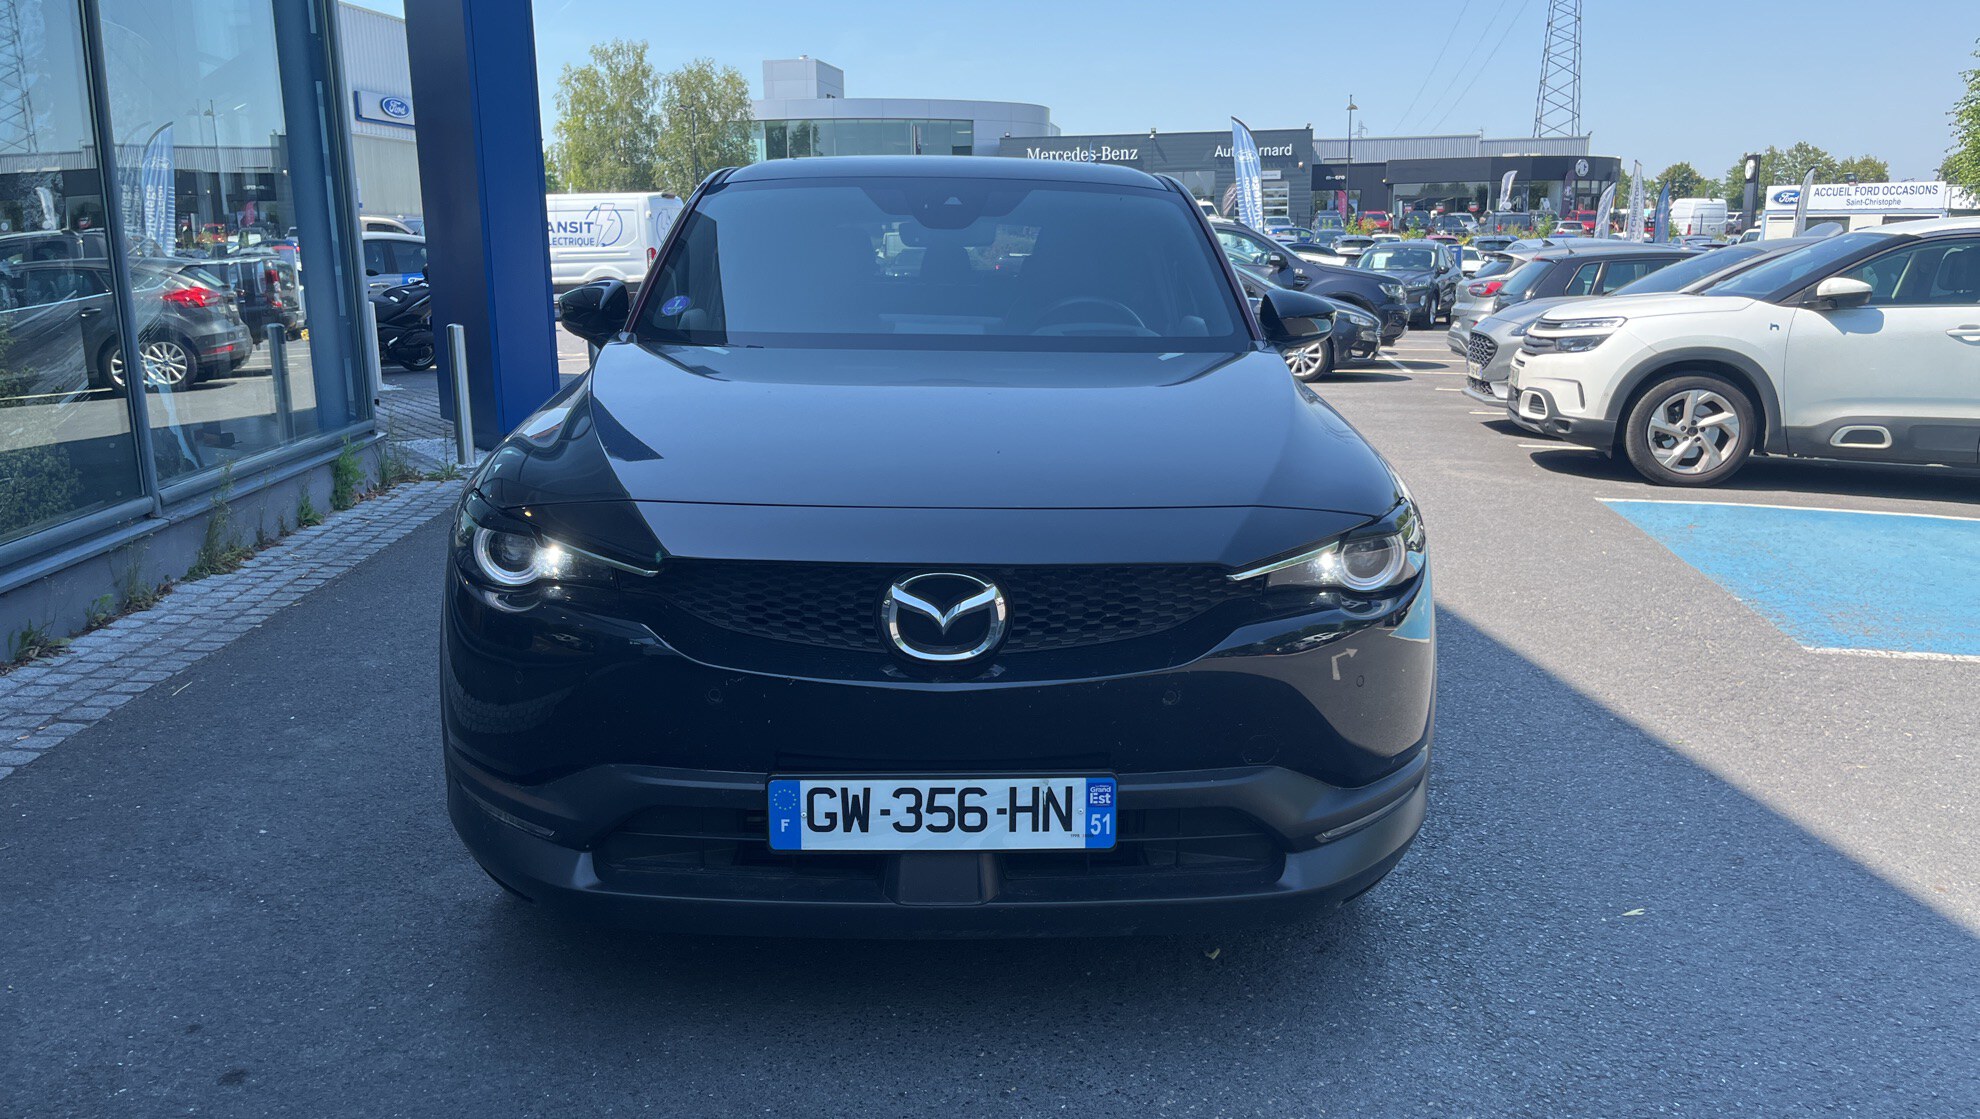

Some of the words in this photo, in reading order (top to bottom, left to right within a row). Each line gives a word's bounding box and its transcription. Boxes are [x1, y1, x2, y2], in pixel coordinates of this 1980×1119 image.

[388, 99, 407, 115] Ford
[1026, 146, 1138, 162] Mercedes-Benz
[1214, 145, 1234, 158] Aut
[1258, 143, 1293, 157] rnard
[1813, 186, 1852, 197] ACCUEIL
[1854, 185, 1880, 196] FORD
[1882, 184, 1939, 196] OCCASIONS
[1845, 198, 1902, 208] Saint-Christophe
[547, 221, 595, 234] ANSIT
[549, 237, 595, 247] ECTRIQUE
[1089, 785, 1112, 793] Grand
[1089, 792, 1111, 804] Est
[806, 785, 1074, 834] GW-356-HN
[780, 818, 791, 833] F
[1090, 812, 1111, 836] 51
